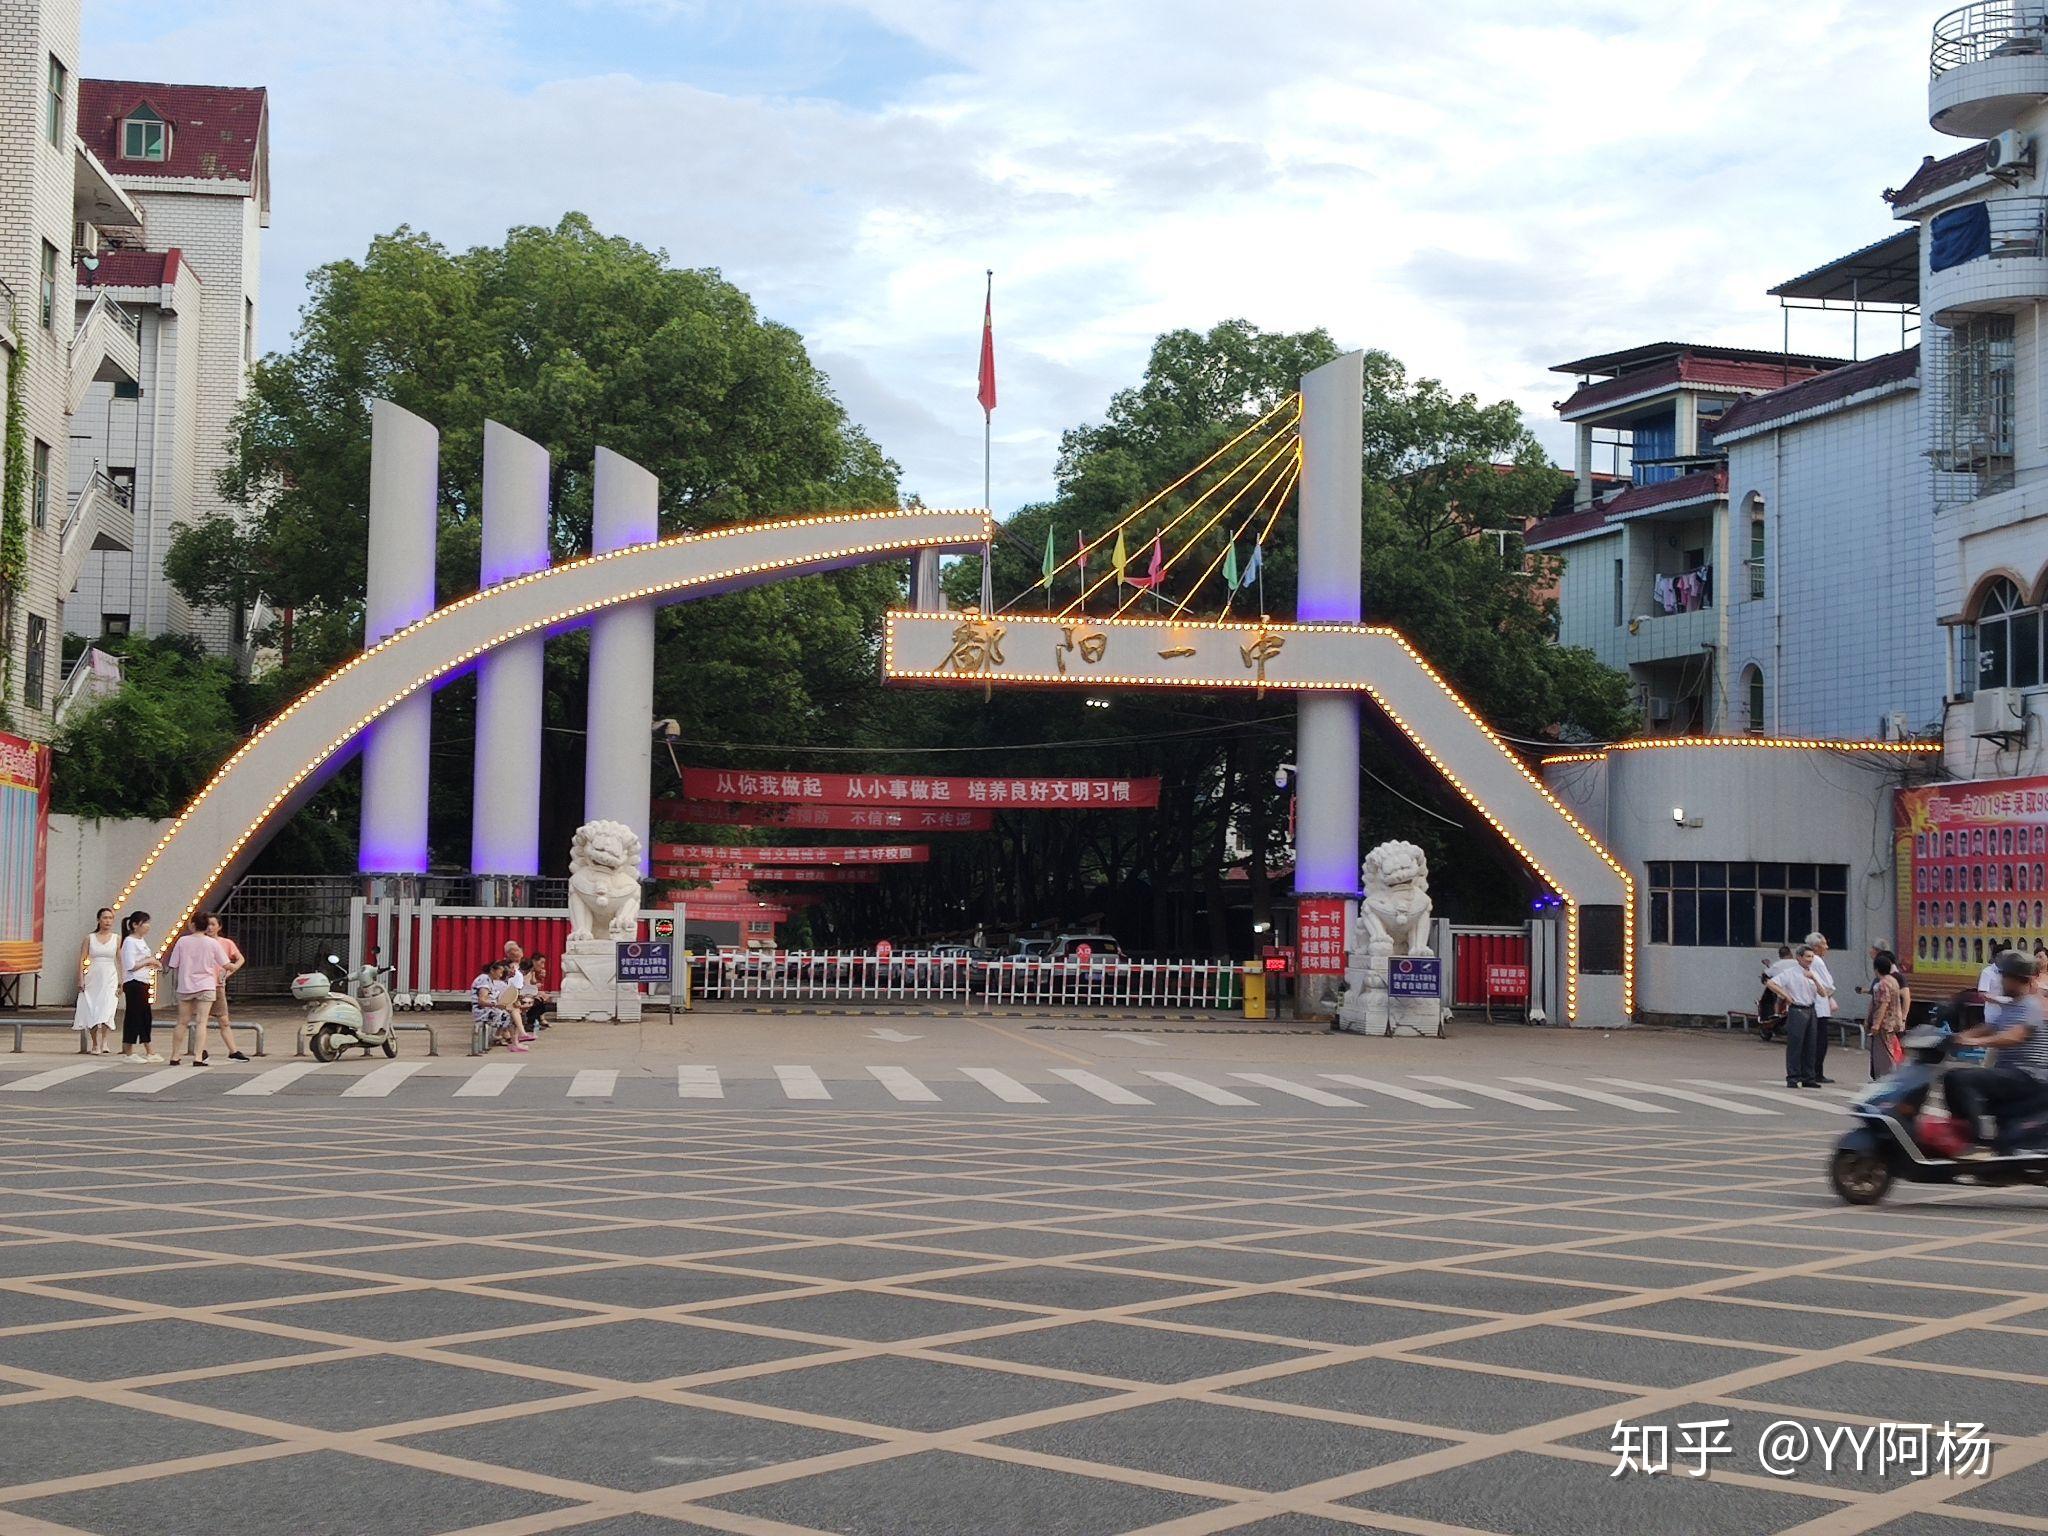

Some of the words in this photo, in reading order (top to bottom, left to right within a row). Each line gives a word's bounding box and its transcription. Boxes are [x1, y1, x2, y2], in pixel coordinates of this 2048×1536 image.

[716, 774, 824, 798] 从你我做起
[847, 778, 951, 801] 从小事做起
[968, 781, 1131, 802] 培养良好文明习惯
[1301, 910, 1341, 924] 一车一杆
